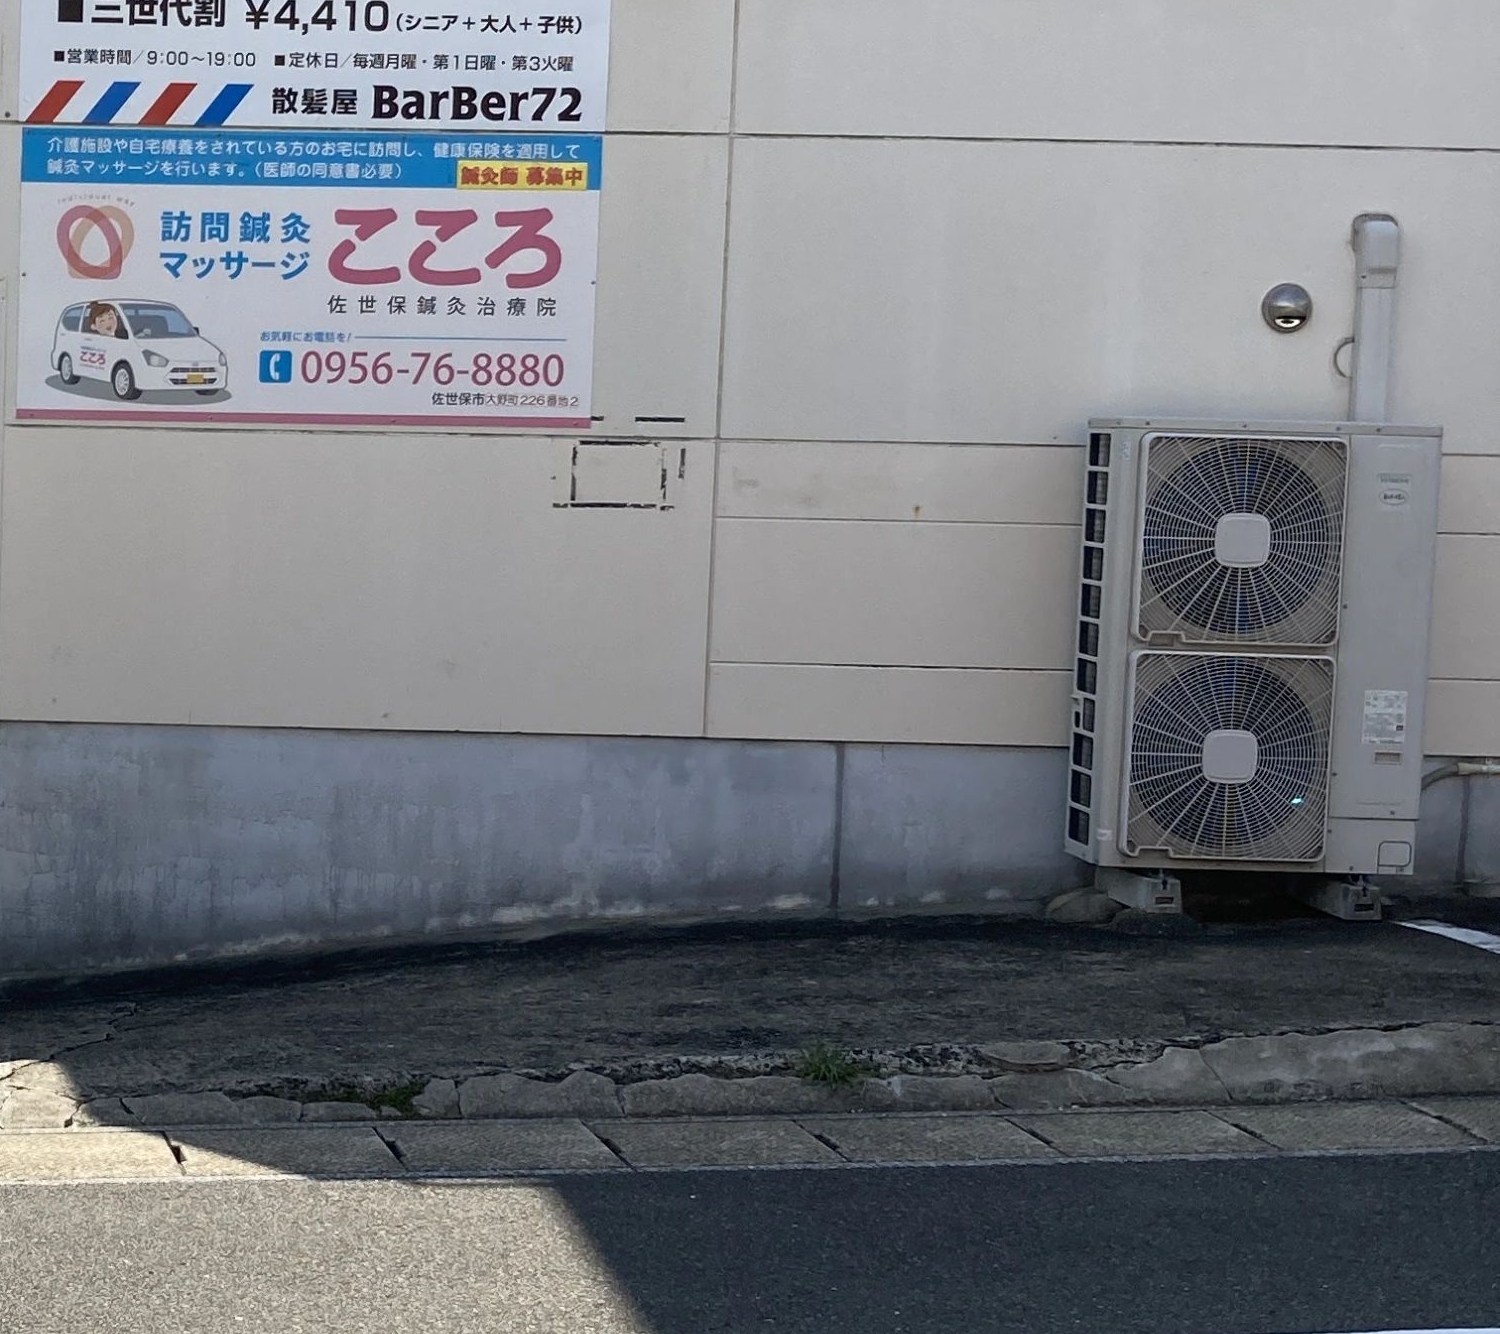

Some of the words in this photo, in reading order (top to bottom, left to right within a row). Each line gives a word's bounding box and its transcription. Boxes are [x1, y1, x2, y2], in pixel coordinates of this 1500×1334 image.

[272, 87, 358, 116] 散髪屋
[371, 84, 582, 123] BarBer72
[526, 166, 583, 187] 募集中
[161, 210, 311, 245] 訪問鍼灸
[158, 249, 310, 281] マッサージ
[327, 207, 562, 289] こころ
[327, 295, 557, 317] 佐世保鍼灸治療院
[300, 350, 565, 387] 0956-76-8880
